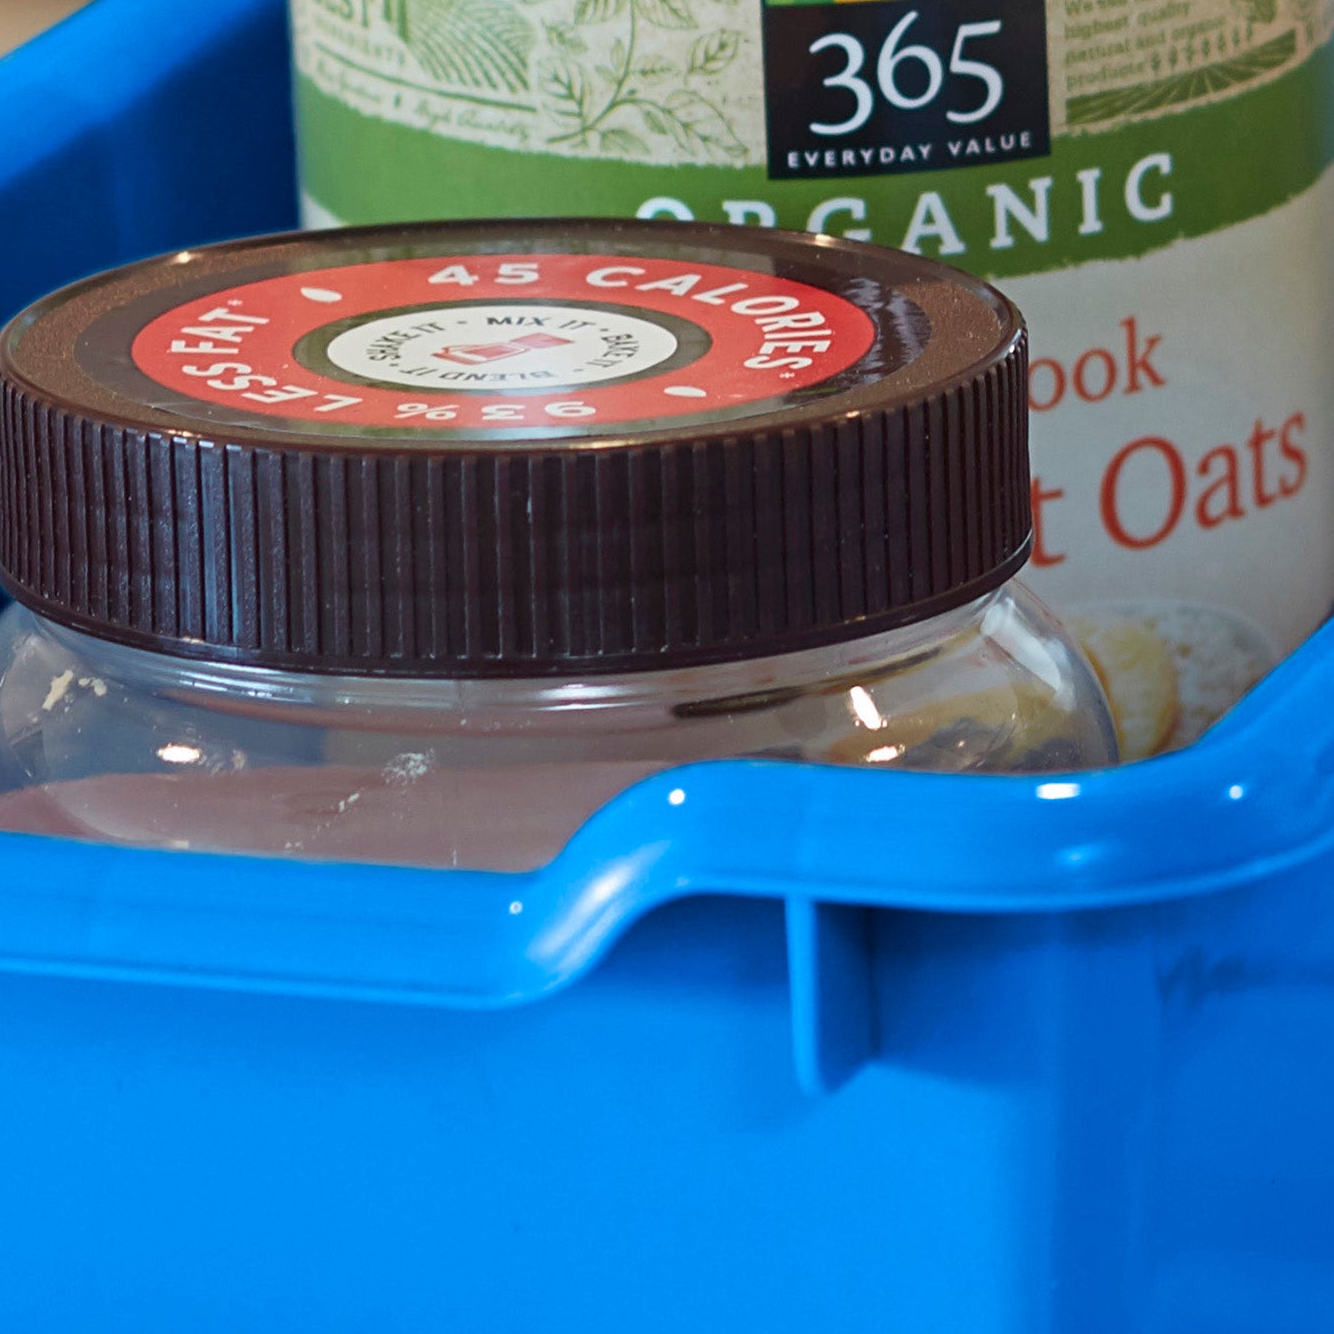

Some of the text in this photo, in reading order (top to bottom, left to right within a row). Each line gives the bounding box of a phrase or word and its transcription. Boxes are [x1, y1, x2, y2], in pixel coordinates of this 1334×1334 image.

[808, 9, 1005, 136] 365
[786, 130, 1033, 169] EVERYDAY VALUE
[427, 262, 541, 286] 45
[412, 322, 446, 335] IT
[485, 316, 597, 332] MIX IT
[398, 366, 555, 381] BLEND IT
[1028, 315, 1167, 411] ook
[180, 361, 364, 413] LESS
[393, 400, 598, 421] 93%
[1099, 410, 1310, 551] Oats
